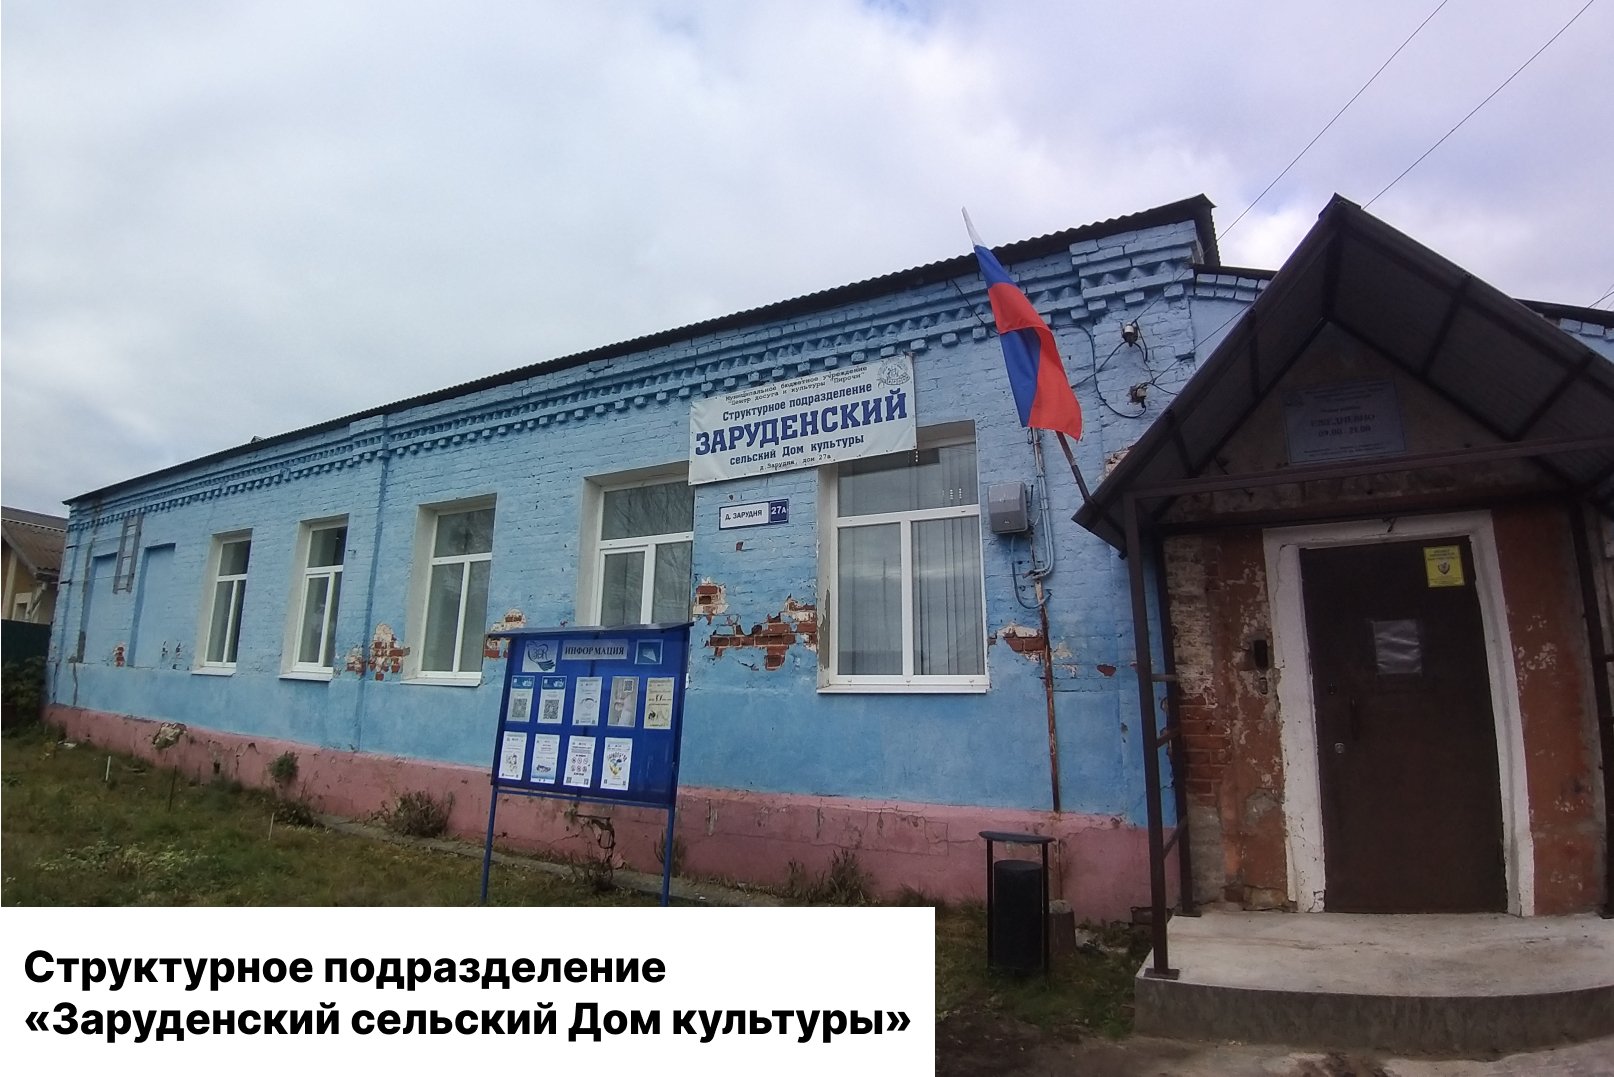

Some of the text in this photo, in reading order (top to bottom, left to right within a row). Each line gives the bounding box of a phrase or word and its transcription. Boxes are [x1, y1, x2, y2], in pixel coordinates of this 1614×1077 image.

[722, 383, 873, 422] Структурное подразделение
[754, 392, 779, 401] досуга
[791, 381, 826, 393] культуры
[695, 388, 908, 456] ЗАРУДЕНСКИЙ
[729, 434, 864, 466] сельский Дом культуры
[733, 509, 763, 519] ЗАРУДНЯ
[771, 505, 787, 515] 27А
[564, 646, 625, 656] ИНФОРМАЦИЯ
